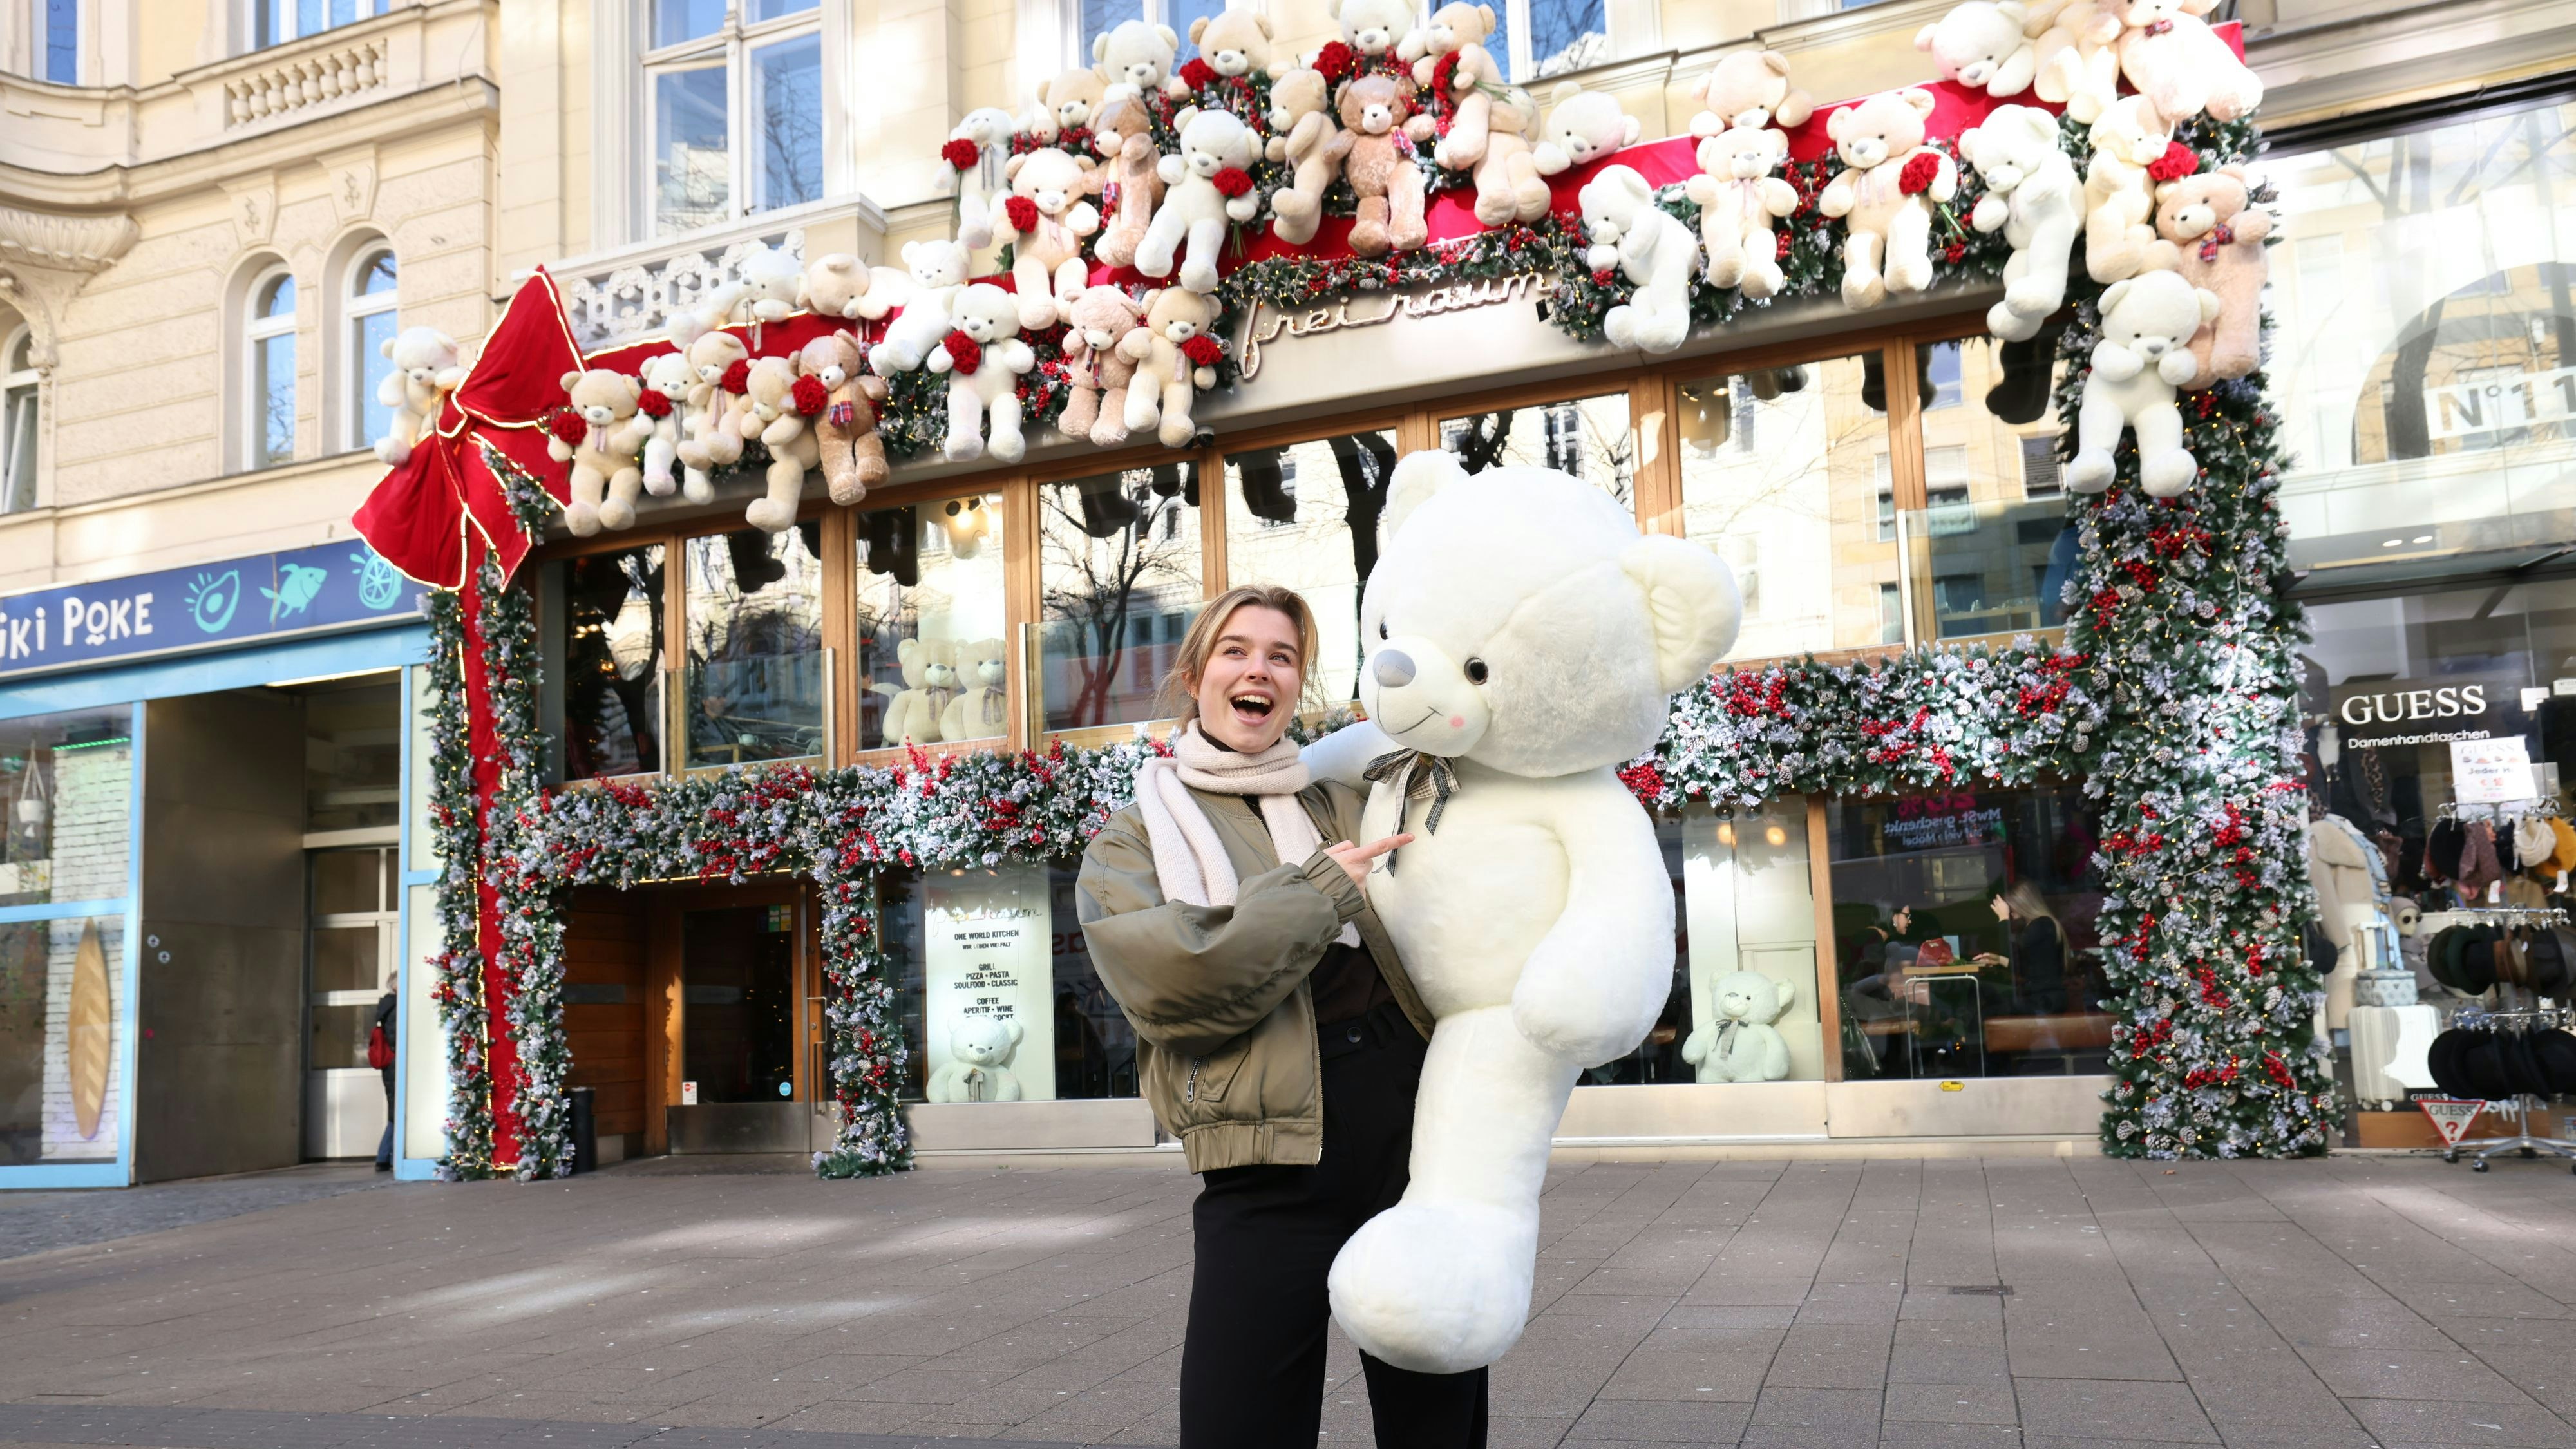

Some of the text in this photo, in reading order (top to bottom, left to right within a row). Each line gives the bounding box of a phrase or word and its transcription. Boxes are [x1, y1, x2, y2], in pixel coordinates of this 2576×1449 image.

[63, 592, 153, 646] POKE
[2341, 685, 2487, 725] GUESS
[2348, 728, 2490, 748] Damenhandtaschen
[969, 931, 990, 940] WORLD
[992, 929, 1019, 938] KITCHEN
[954, 979, 1018, 989] SOULFOOD CLASSIC
[976, 997, 999, 1005] COFFEE
[2429, 1104, 2474, 1116] GUESS
